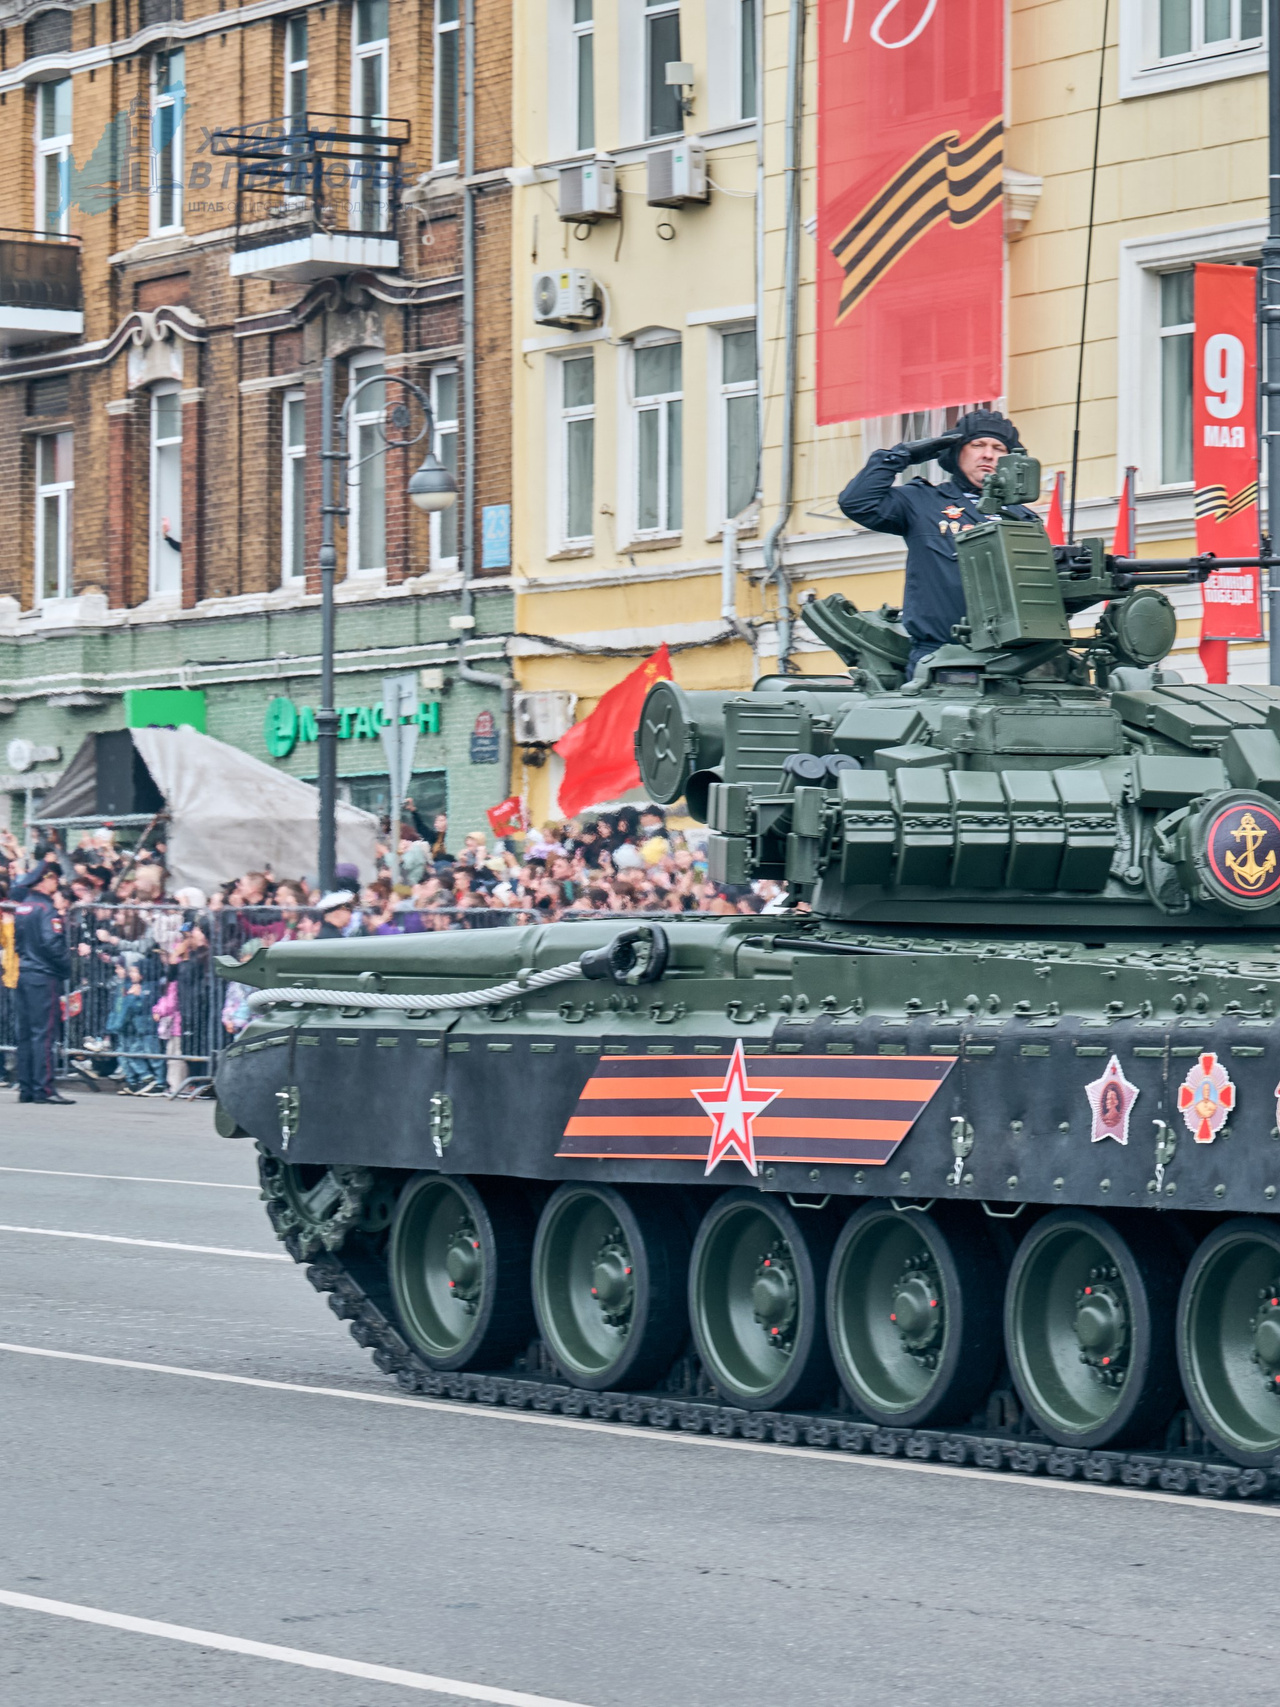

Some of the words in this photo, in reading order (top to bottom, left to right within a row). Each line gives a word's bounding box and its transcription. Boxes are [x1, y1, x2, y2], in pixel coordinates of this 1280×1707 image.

[1203, 333, 1245, 420] 9
[1203, 425, 1246, 448] МАЯ
[486, 509, 506, 539] 23
[299, 701, 440, 743] МГАН
